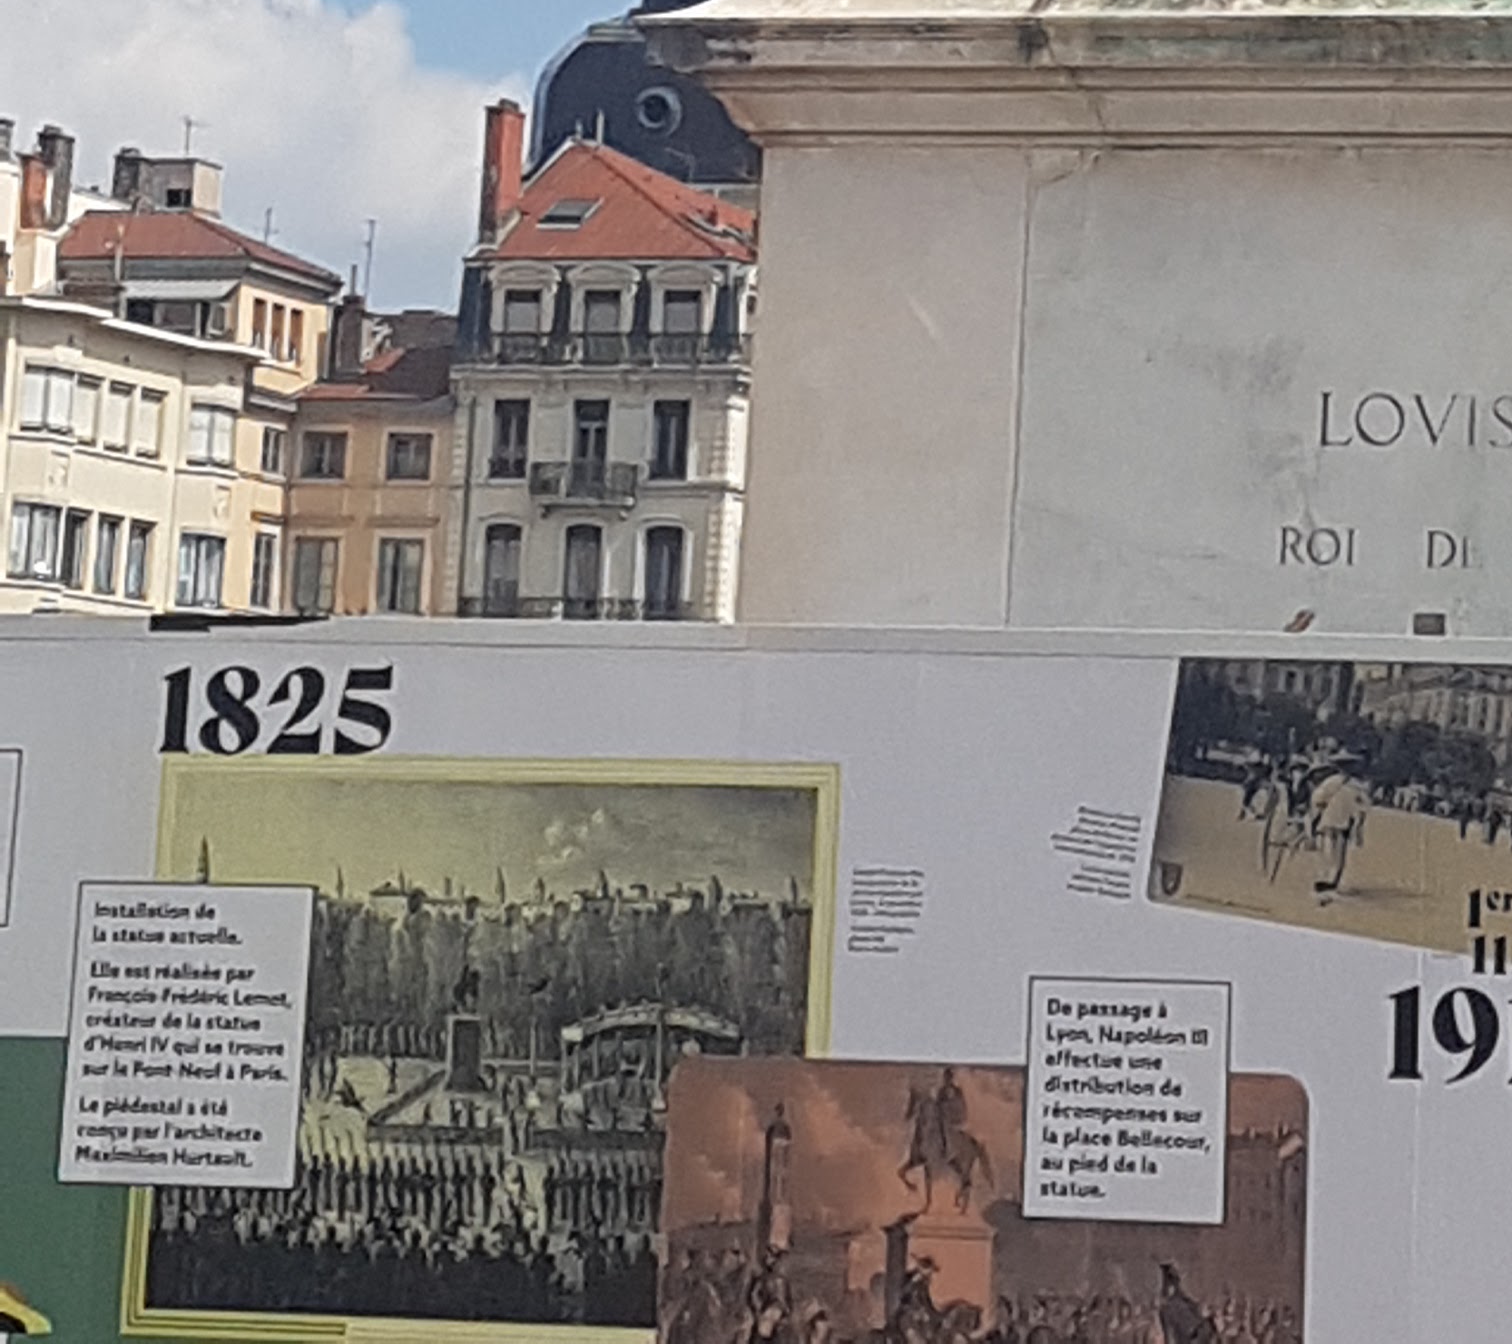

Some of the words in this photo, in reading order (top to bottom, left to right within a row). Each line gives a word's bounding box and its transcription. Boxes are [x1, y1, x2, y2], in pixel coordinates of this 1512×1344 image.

[1279, 525, 1356, 567] ROI
[159, 666, 394, 755] 1825
[1472, 936, 1506, 975] 11
[226, 968, 255, 984] par
[162, 1012, 182, 1029] de
[186, 1013, 200, 1029] la
[1048, 998, 1072, 1016] De
[1078, 1003, 1151, 1023] passage
[1045, 1050, 1122, 1069] effectue
[1045, 1076, 1154, 1096] distribution
[1160, 1079, 1181, 1096] de
[1043, 1126, 1057, 1144] la
[1064, 1126, 1111, 1149] place
[1117, 1130, 1210, 1153] Bellecour,
[1041, 1157, 1063, 1171] au
[1069, 1154, 1108, 1174] pied
[1114, 1156, 1135, 1172] de
[1141, 1156, 1157, 1174] la
